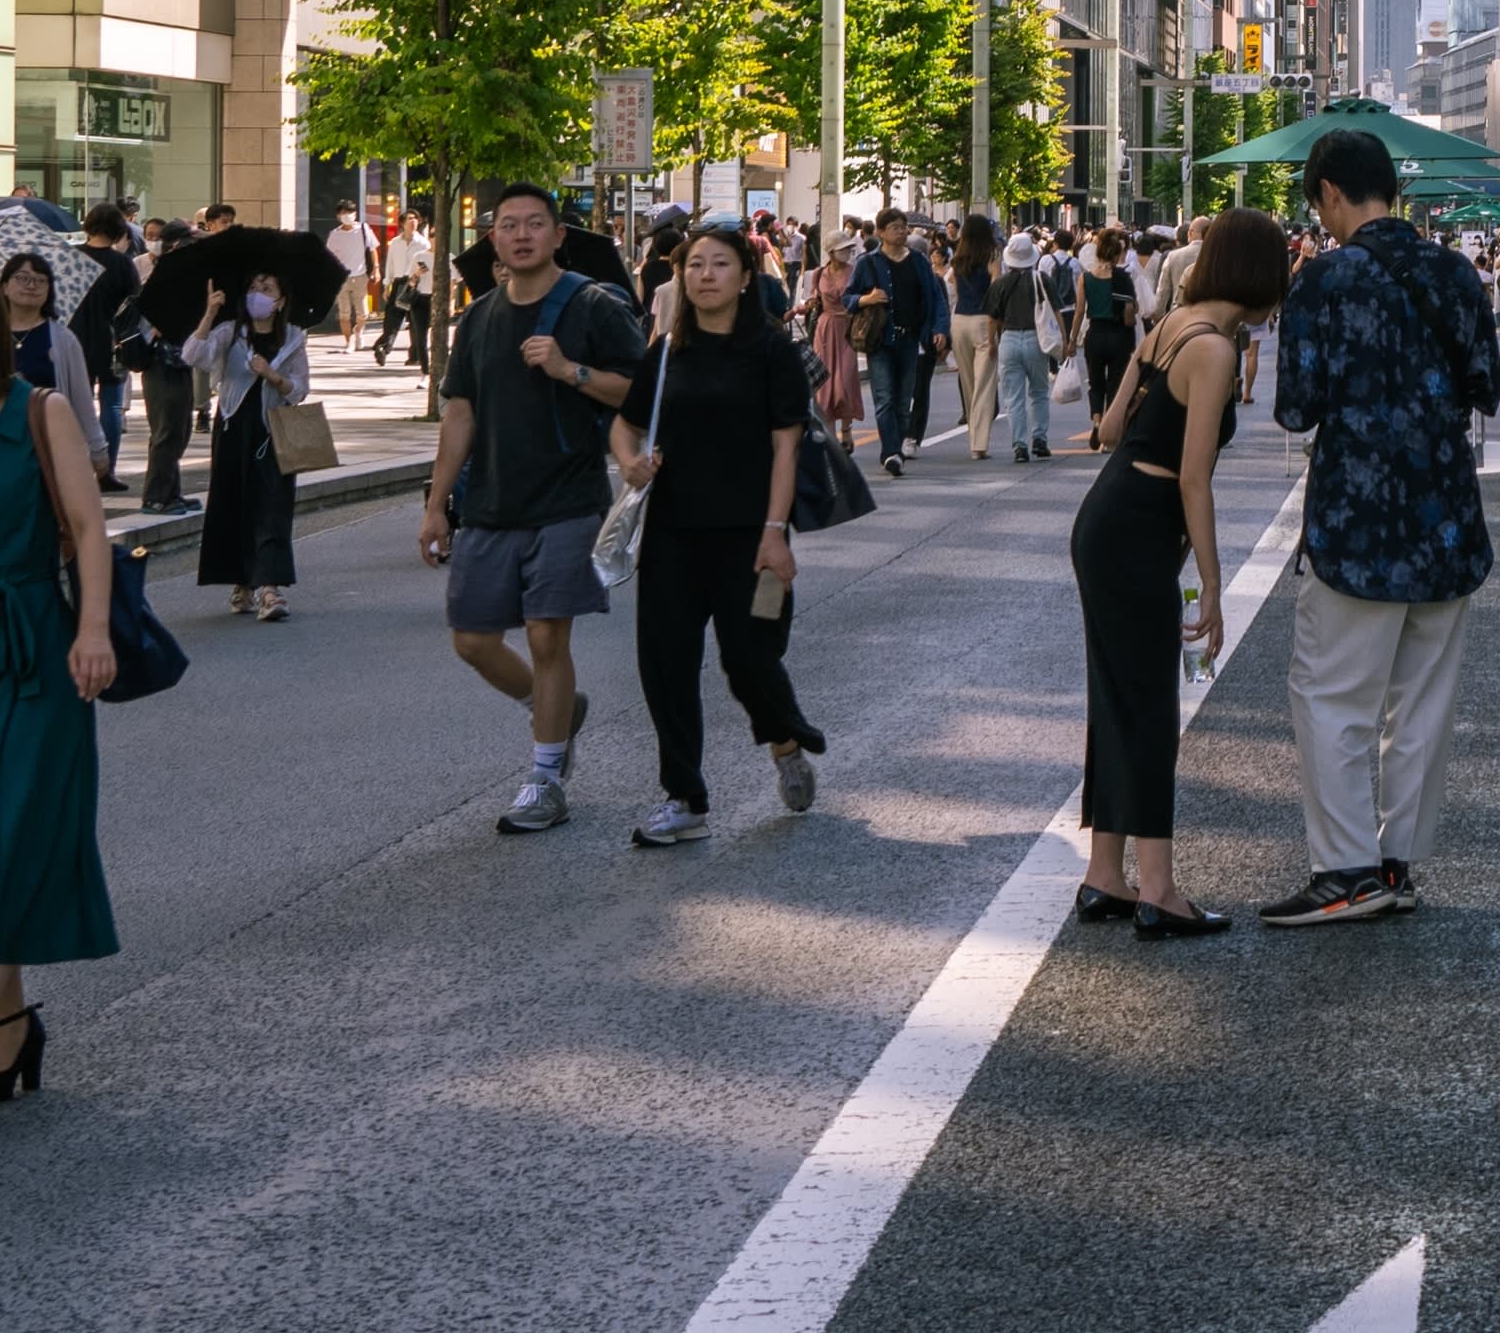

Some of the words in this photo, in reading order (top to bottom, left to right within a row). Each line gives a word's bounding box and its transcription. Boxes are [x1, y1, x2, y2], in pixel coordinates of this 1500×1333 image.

[1214, 76, 1260, 88] 銀座五丁目
